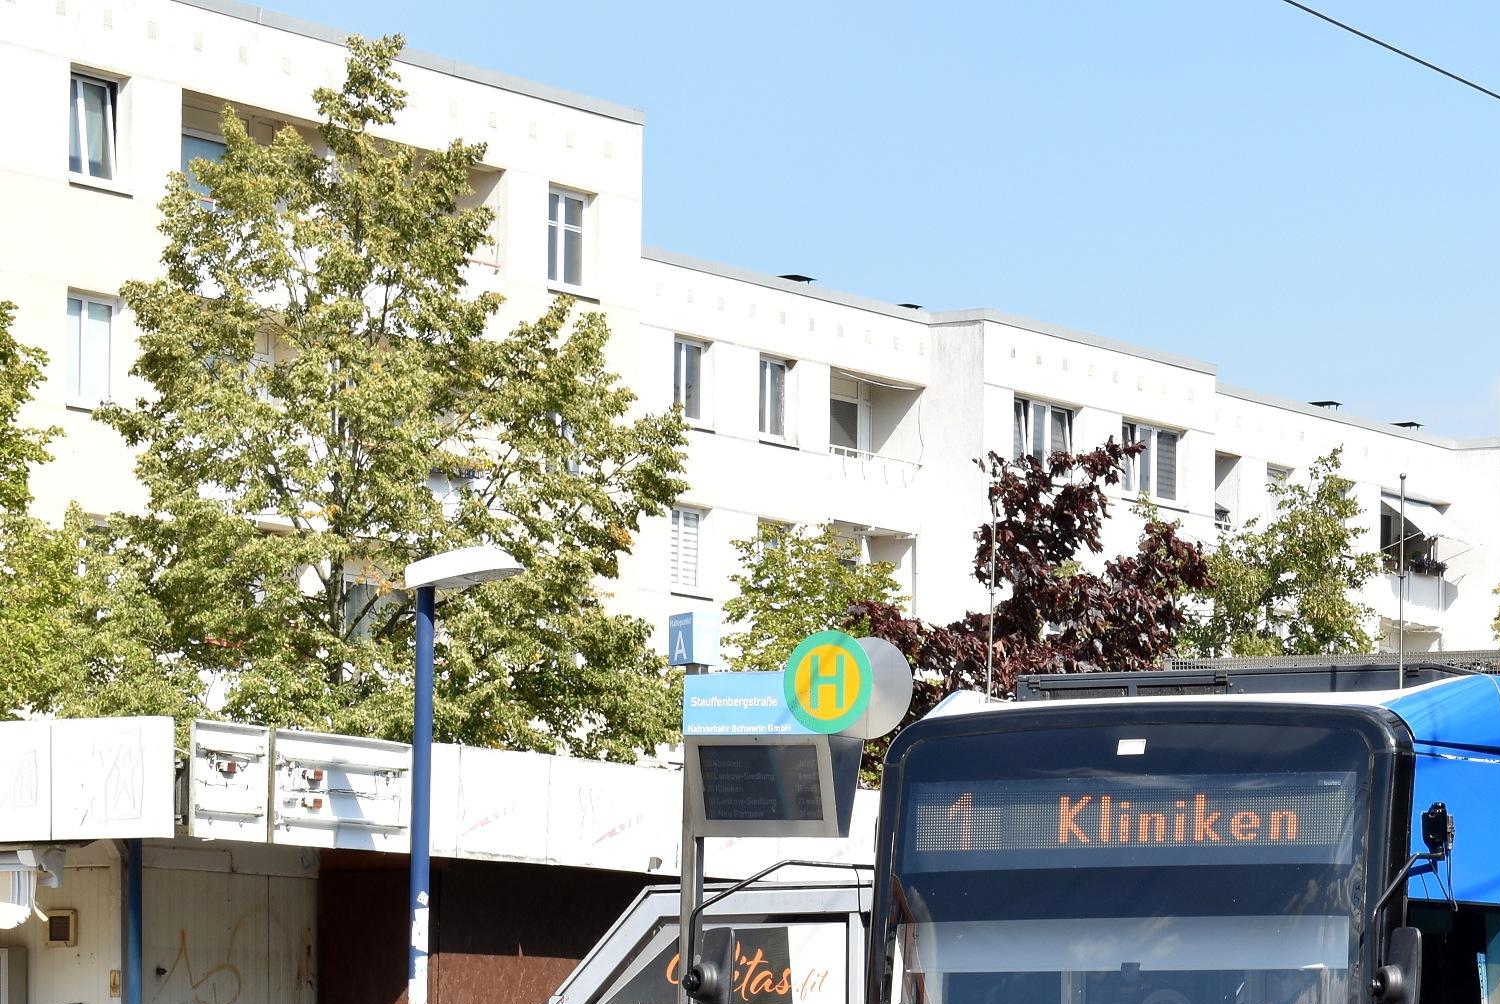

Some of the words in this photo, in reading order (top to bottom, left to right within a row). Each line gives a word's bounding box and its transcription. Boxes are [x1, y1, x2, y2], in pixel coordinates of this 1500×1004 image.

[673, 630, 688, 662] A
[809, 654, 845, 710] H
[690, 696, 778, 708] Stauffenbergstraße
[688, 724, 730, 733] Nahverkehr
[731, 724, 766, 733] Schwerin
[767, 724, 792, 733] GmbH
[1058, 794, 1300, 844] Kliniken
